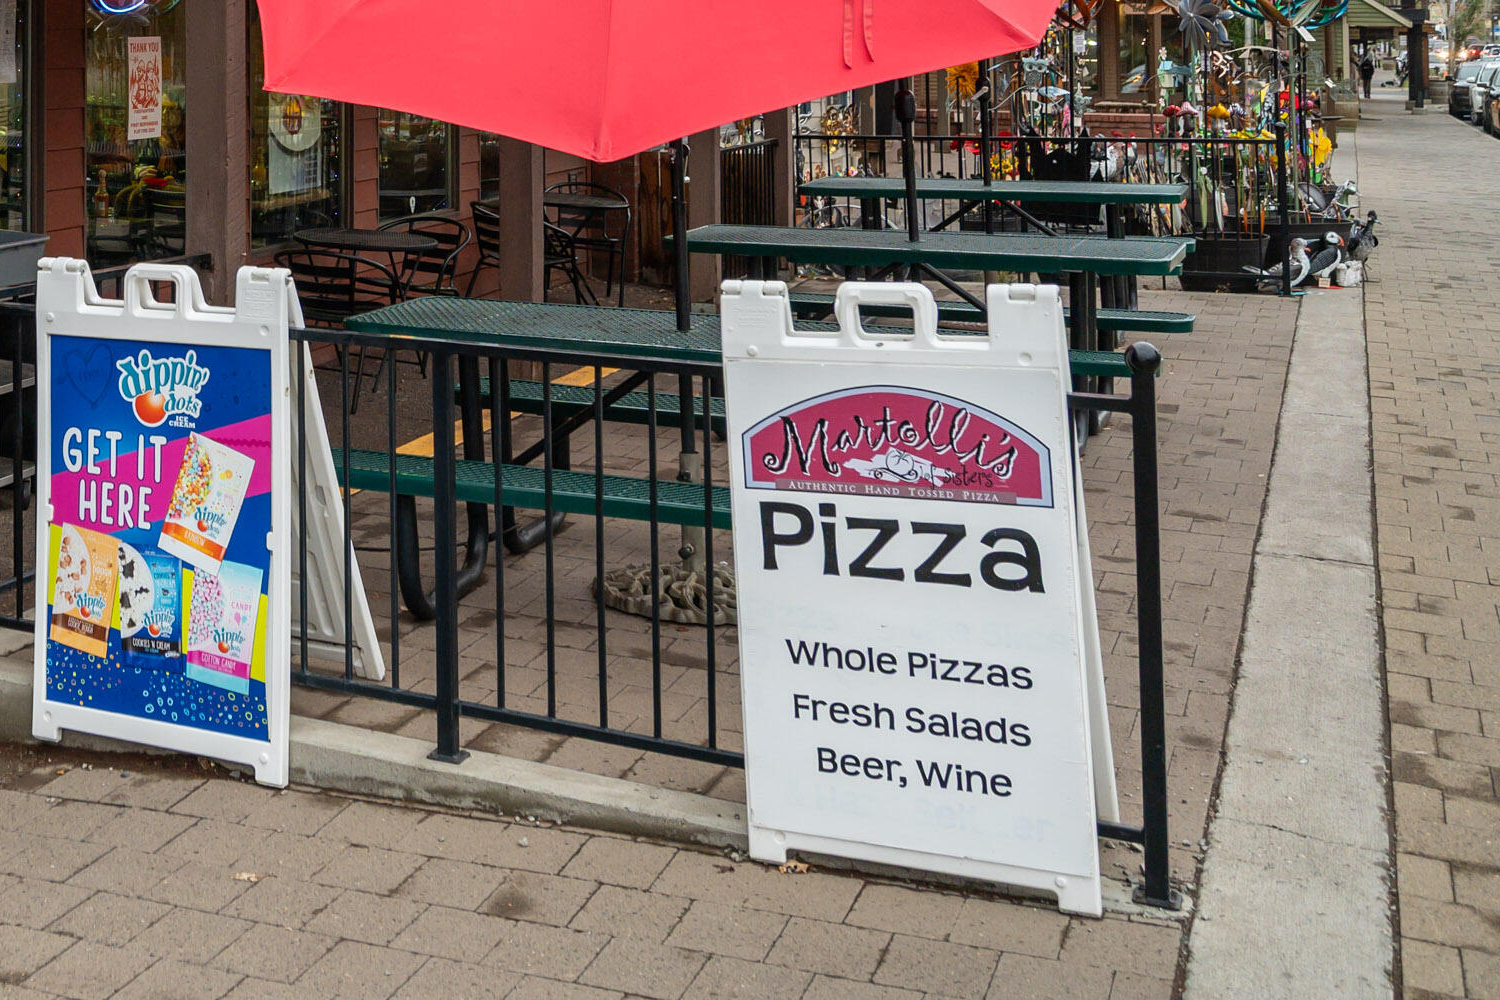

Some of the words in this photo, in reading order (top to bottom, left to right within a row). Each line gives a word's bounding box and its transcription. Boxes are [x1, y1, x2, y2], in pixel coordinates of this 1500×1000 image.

[129, 43, 147, 53] THANK
[148, 42, 159, 53] YOU
[164, 392, 201, 416] dots
[168, 420, 196, 428] CREAM
[763, 400, 1018, 479] Martolli's
[63, 427, 122, 478] GET
[138, 434, 167, 483] IT
[788, 480, 856, 494] AUTHENTIC
[865, 485, 900, 496] HAND
[908, 487, 954, 500] TOSSED
[963, 490, 1000, 503] PIZZA
[924, 464, 937, 489] of
[943, 464, 994, 488] Sisters
[79, 479, 152, 530] HERE
[758, 500, 1046, 594] Pizza
[132, 638, 150, 648] COOKIES
[157, 641, 171, 650] CREAM
[202, 653, 221, 666] COTTON
[222, 657, 236, 671] CANDY
[785, 638, 898, 676] Whole
[908, 651, 1034, 690] Pizzas
[793, 693, 895, 730] Fresh
[905, 706, 1032, 747] Salads
[817, 746, 907, 788] Beer,
[916, 758, 1013, 797] Wine
